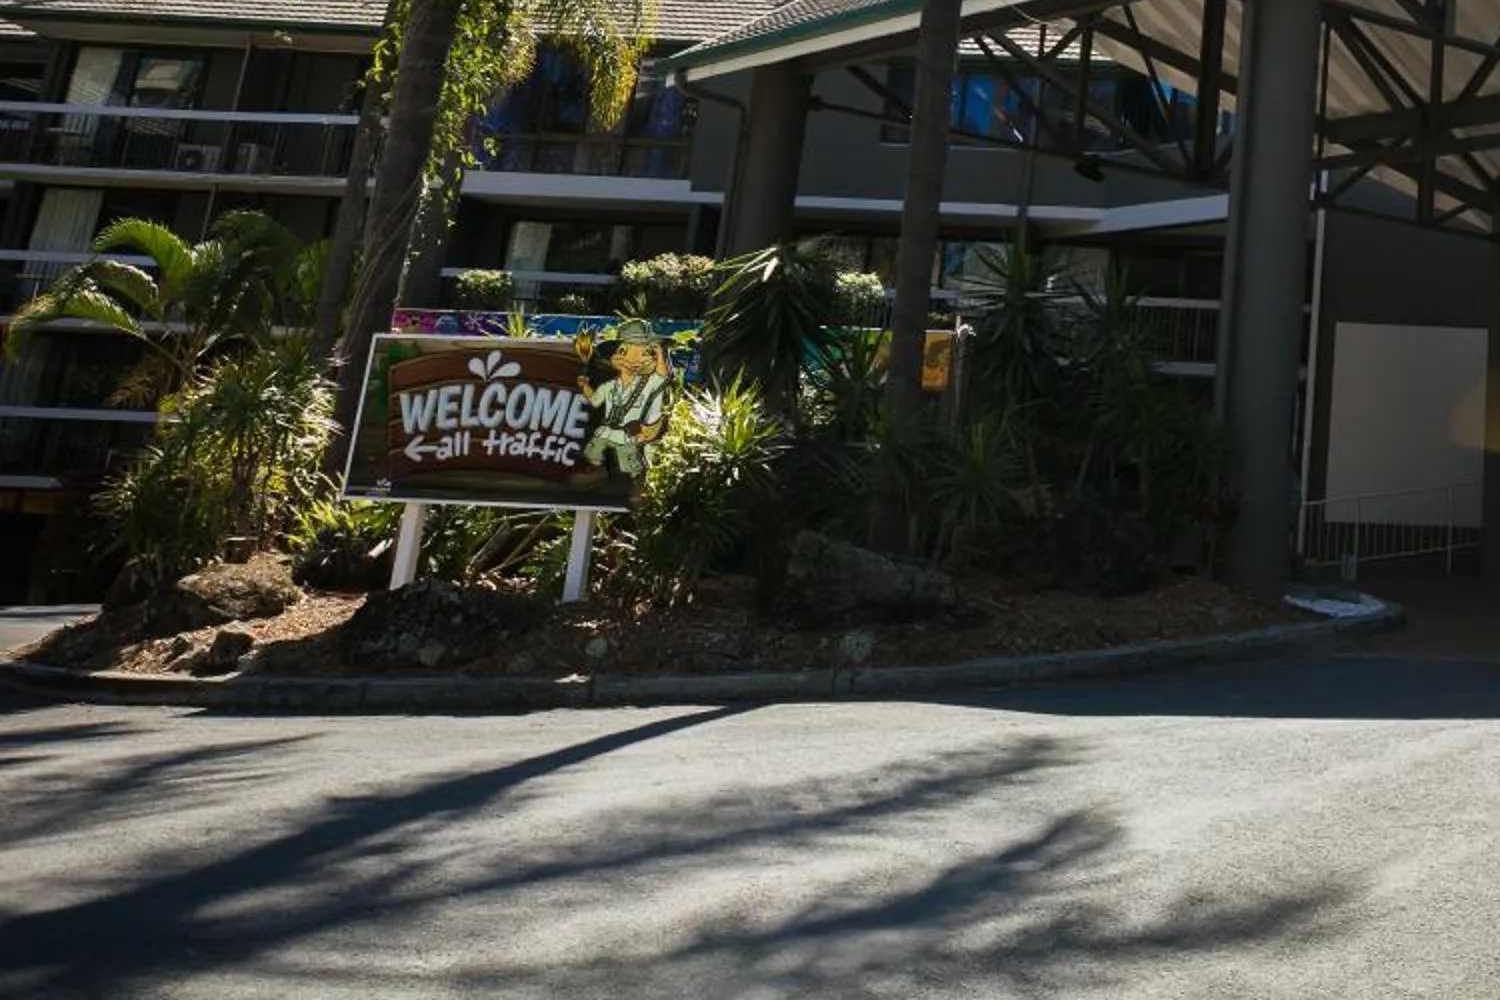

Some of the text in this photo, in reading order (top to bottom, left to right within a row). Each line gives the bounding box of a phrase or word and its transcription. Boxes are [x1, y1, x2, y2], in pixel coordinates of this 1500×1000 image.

[401, 382, 589, 437] WELCOME
[437, 430, 580, 467] all traffic
